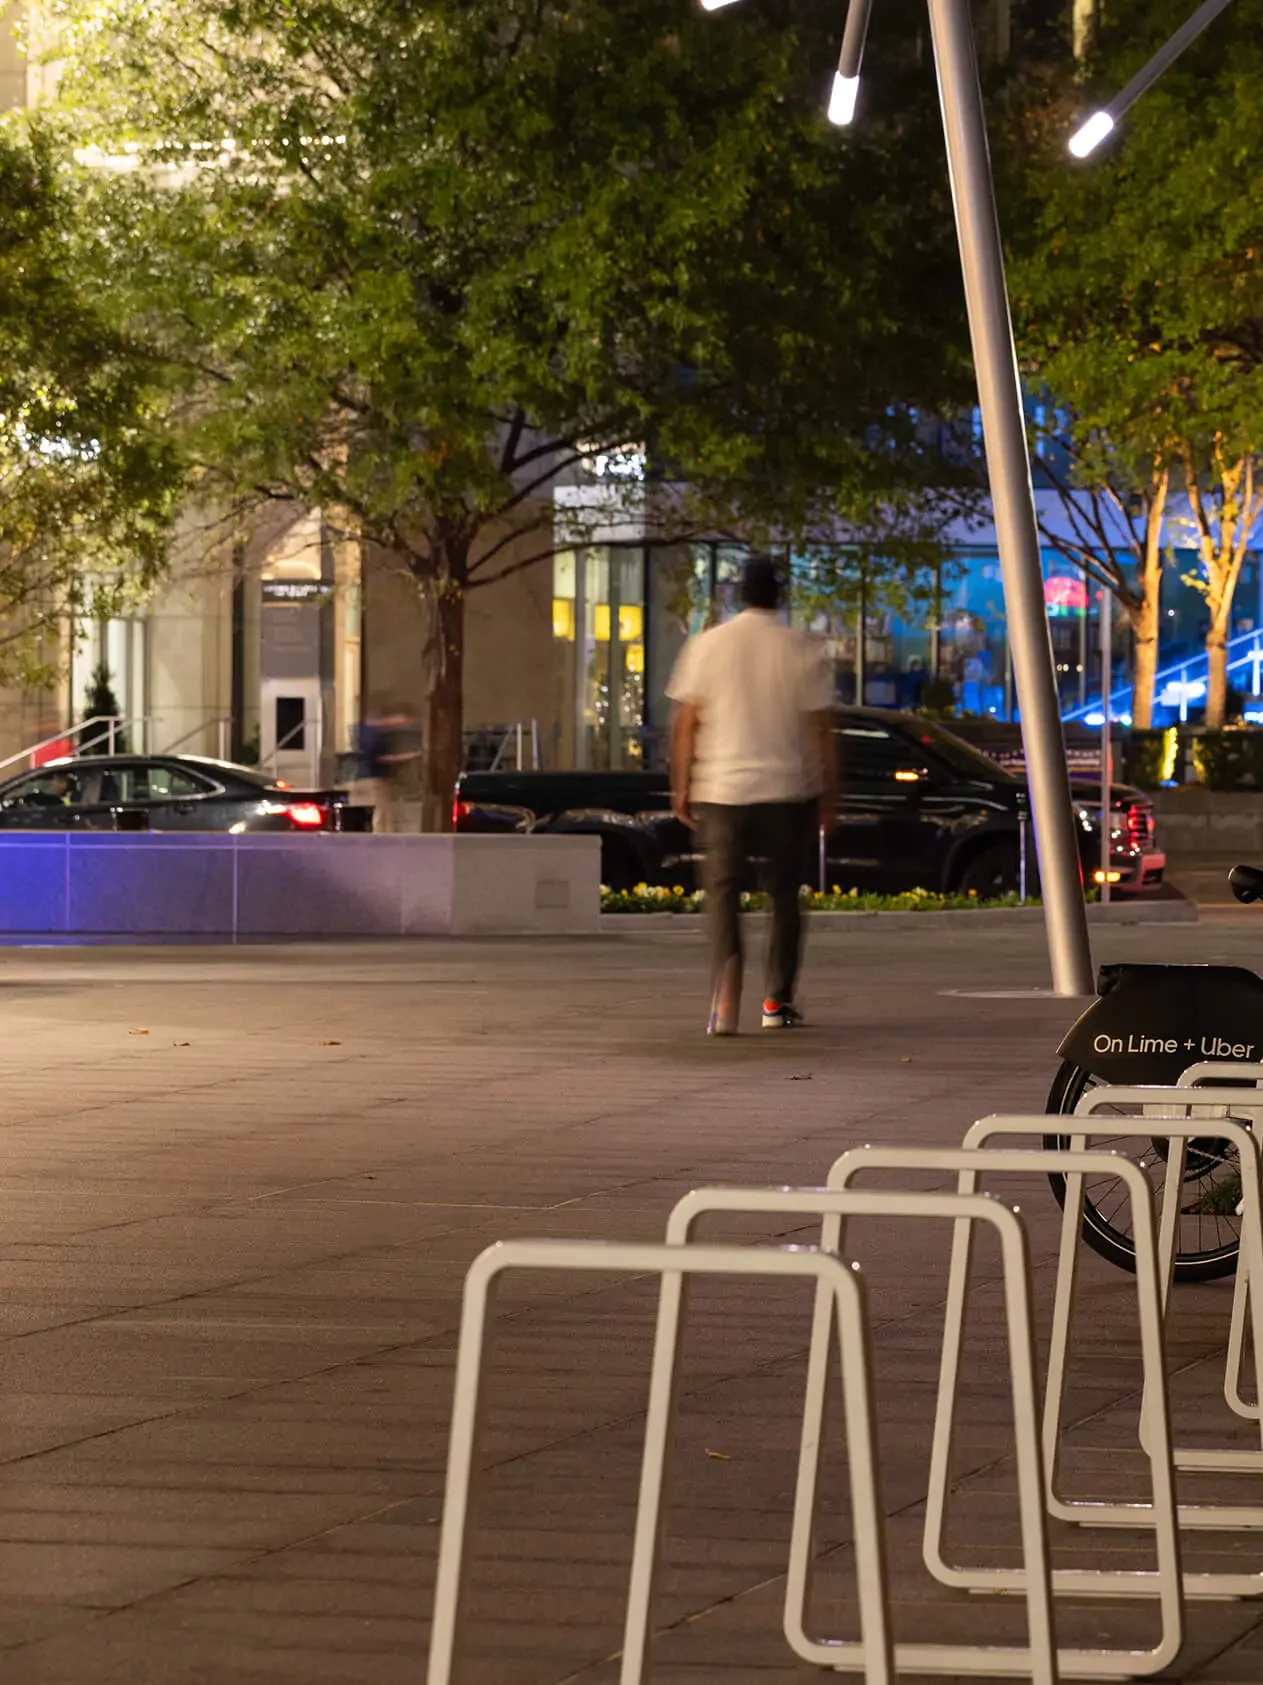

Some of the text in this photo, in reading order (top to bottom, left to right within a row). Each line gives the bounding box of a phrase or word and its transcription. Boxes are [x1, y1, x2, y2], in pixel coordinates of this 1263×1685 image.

[1094, 1034, 1255, 1058] On Lime + Uber
